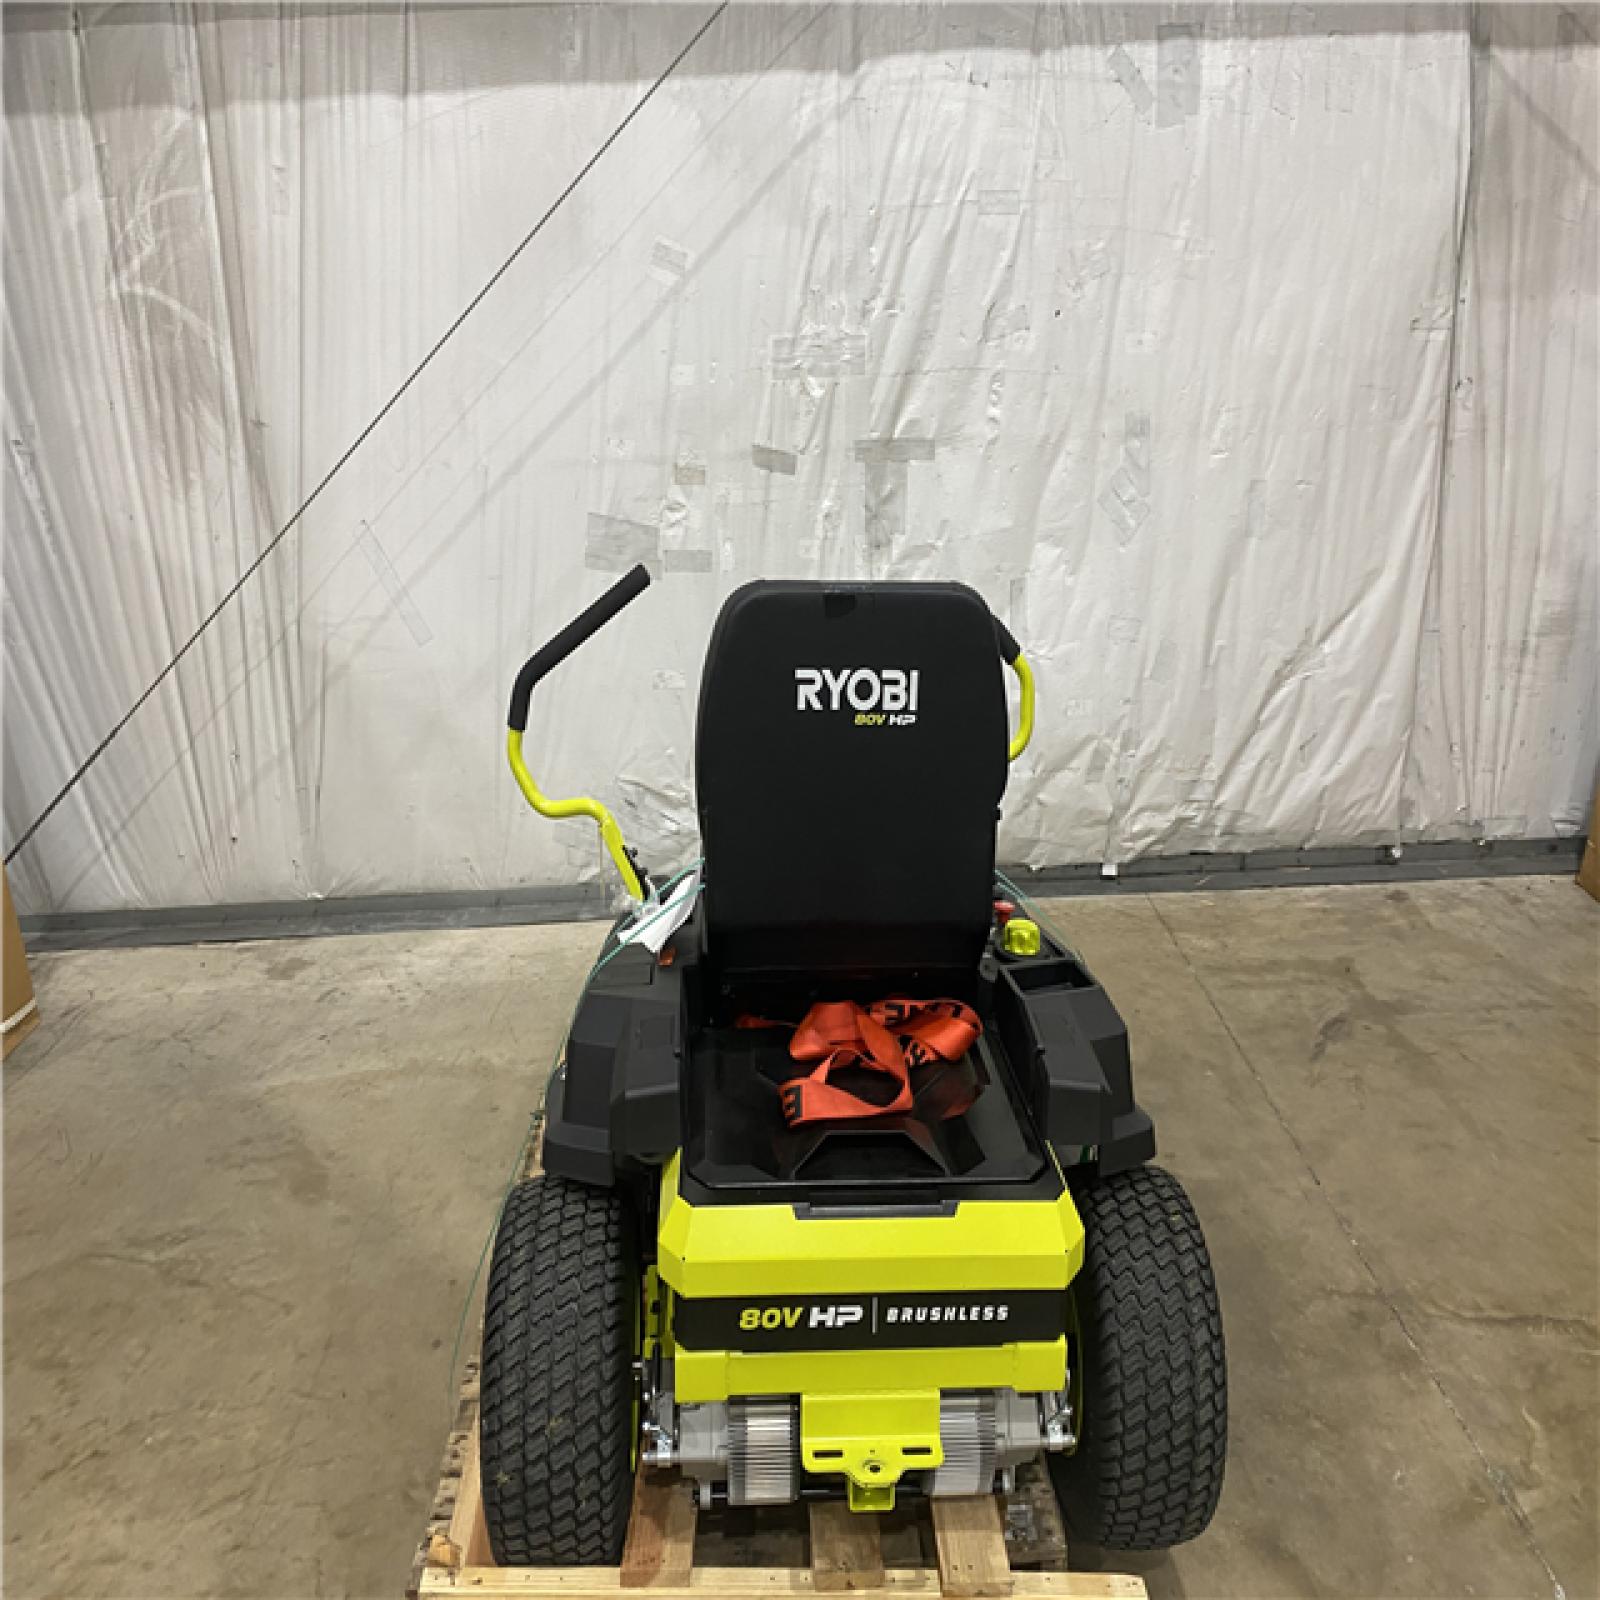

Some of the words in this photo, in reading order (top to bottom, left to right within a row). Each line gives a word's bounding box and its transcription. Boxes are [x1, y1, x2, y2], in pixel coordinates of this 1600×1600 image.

[794, 668, 920, 711] RYOBI
[854, 713, 886, 726] 80V
[889, 714, 916, 726] HP
[739, 1307, 803, 1331] 80V
[808, 1304, 864, 1329] HP
[886, 1304, 1009, 1323] BRUSHLESS
